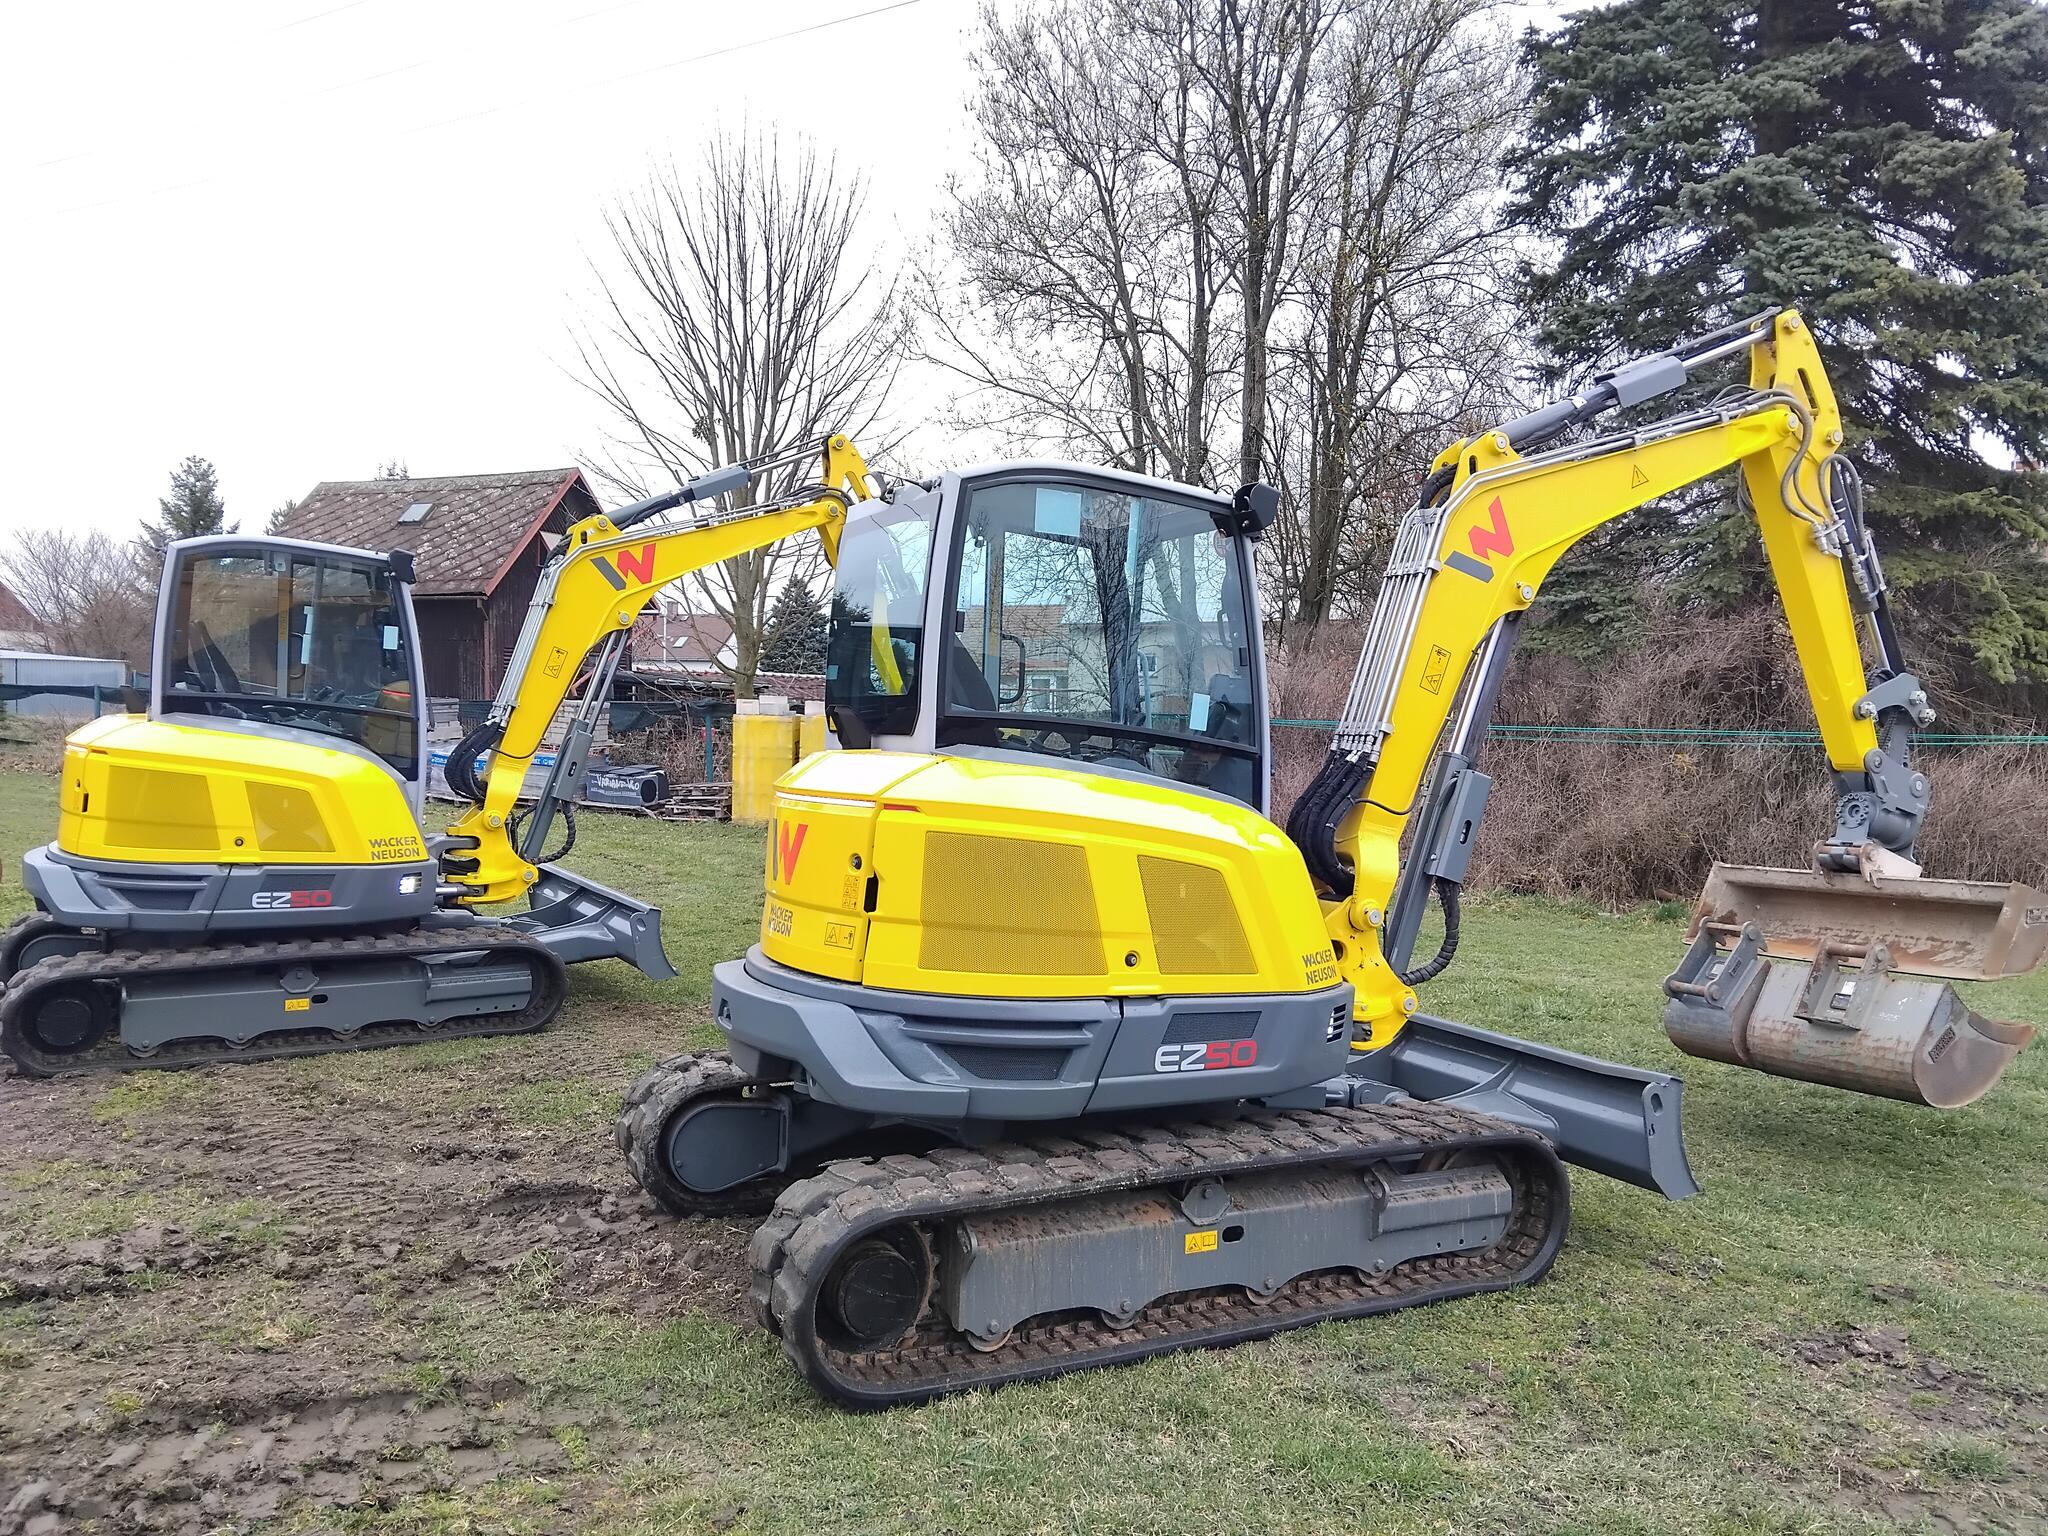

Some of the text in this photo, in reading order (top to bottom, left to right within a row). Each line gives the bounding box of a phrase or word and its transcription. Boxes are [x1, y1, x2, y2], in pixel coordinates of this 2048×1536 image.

[369, 836, 418, 849] WACKER
[371, 848, 420, 861] NEUSON
[252, 891, 331, 909] EZ50
[1302, 949, 1333, 967] WACKER
[1305, 965, 1338, 985] NEUSON
[1155, 1040, 1257, 1072] EZ50
